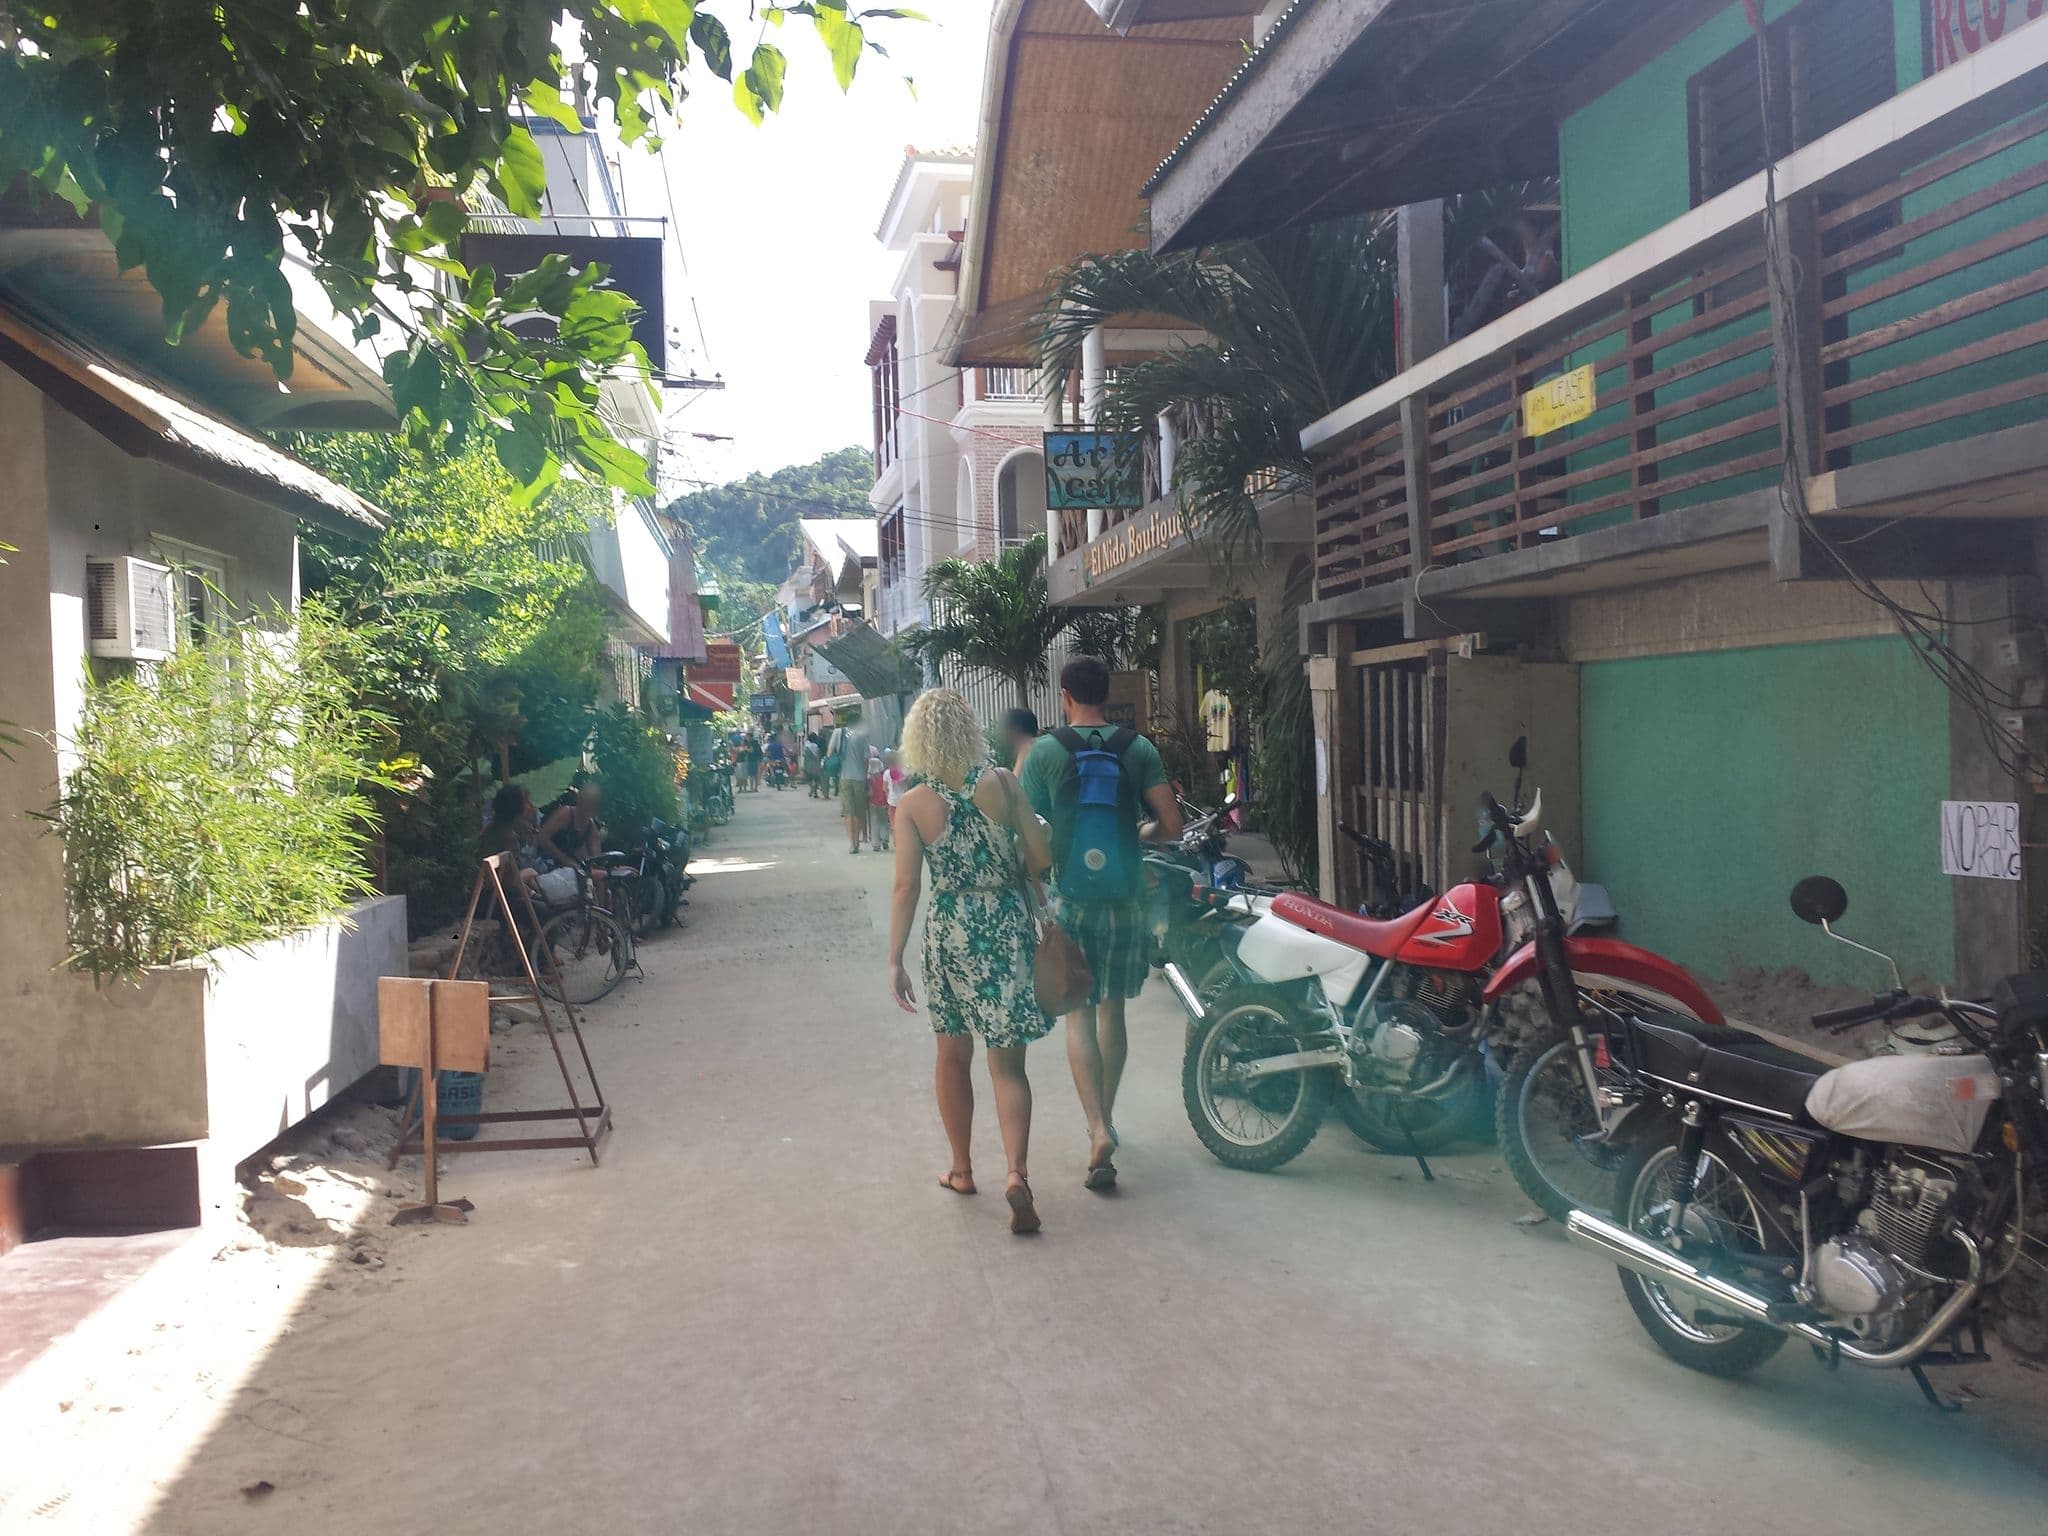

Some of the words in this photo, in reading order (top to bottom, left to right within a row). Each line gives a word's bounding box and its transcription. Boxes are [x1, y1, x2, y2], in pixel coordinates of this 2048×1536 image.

[1551, 371, 1585, 409] LEASE
[1091, 544, 1101, 576] El
[1102, 535, 1126, 571] Nido
[1944, 804, 1976, 871] NO
[1283, 900, 1333, 929] HONDA
